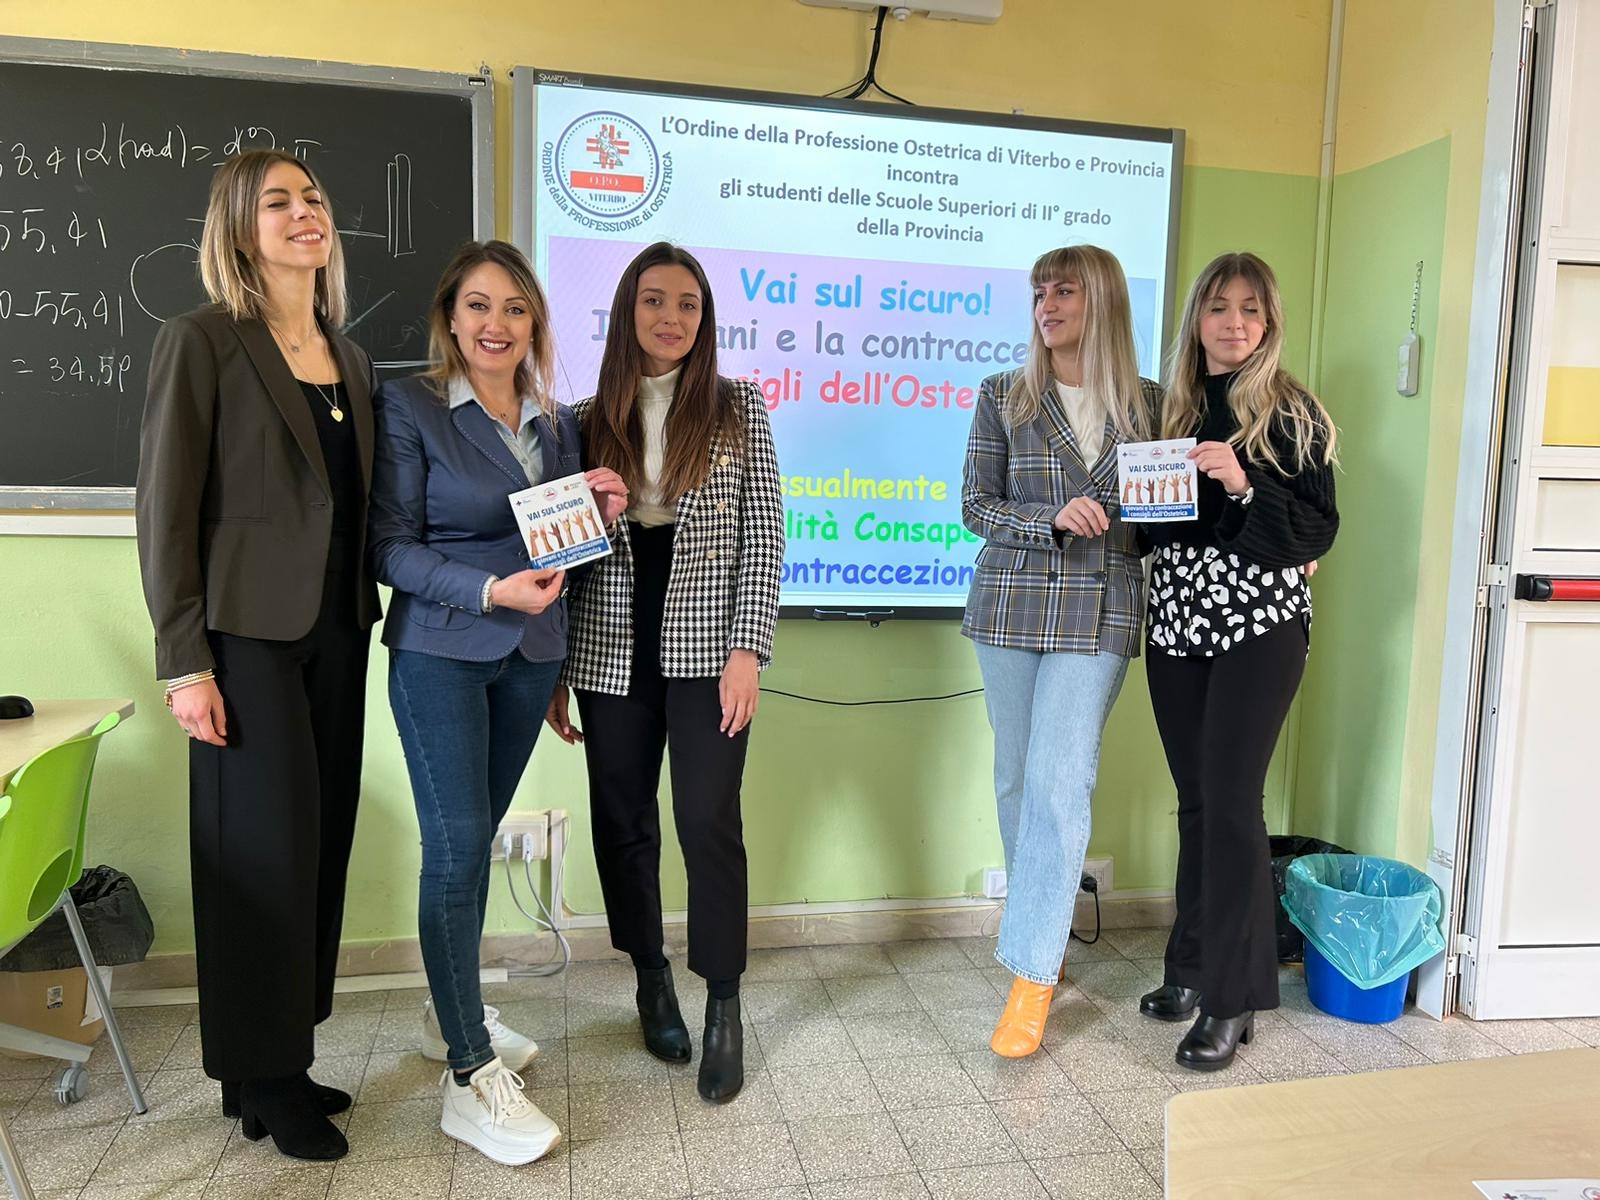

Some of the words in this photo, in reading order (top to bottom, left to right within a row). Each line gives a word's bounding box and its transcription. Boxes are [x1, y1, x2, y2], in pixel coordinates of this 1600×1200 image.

[661, 116, 739, 140] L'Ordine
[744, 124, 789, 144] della
[794, 129, 899, 154] Professione
[903, 138, 981, 162] Ostetrica
[987, 145, 1003, 163] di
[1008, 149, 1071, 170] Viterbo
[1075, 159, 1086, 171] e
[1090, 157, 1165, 178] Provincia
[542, 141, 556, 186] ORDINE
[887, 165, 959, 187] incontra
[650, 150, 673, 213] OSTETRICA
[548, 186, 569, 212] della
[588, 193, 627, 204] VITERBO
[720, 178, 741, 199] gli
[746, 182, 823, 203] studenti
[827, 186, 871, 206] delle
[876, 191, 933, 212] Scuole
[937, 196, 1016, 219] Superiori
[1021, 202, 1037, 220] di
[1063, 208, 1112, 226] grado
[567, 207, 644, 232] PROFESSIONE
[642, 210, 653, 221] di
[857, 217, 900, 237] della
[904, 221, 984, 243] Provincia
[740, 267, 798, 305] Vai
[814, 274, 862, 308] sul
[879, 280, 992, 316] sicuro!
[776, 328, 797, 352] e
[815, 320, 845, 357] la
[861, 330, 1028, 364] contracce
[819, 369, 976, 409] dell'Oste
[1129, 464, 1142, 473] VAI
[1143, 464, 1157, 473] SUL
[1158, 462, 1186, 472] SICURO
[527, 511, 541, 521] VAI
[541, 507, 557, 518] SUL
[557, 497, 584, 513] SICURO
[854, 511, 980, 551] Consape
[779, 557, 976, 587] ontraccezion
